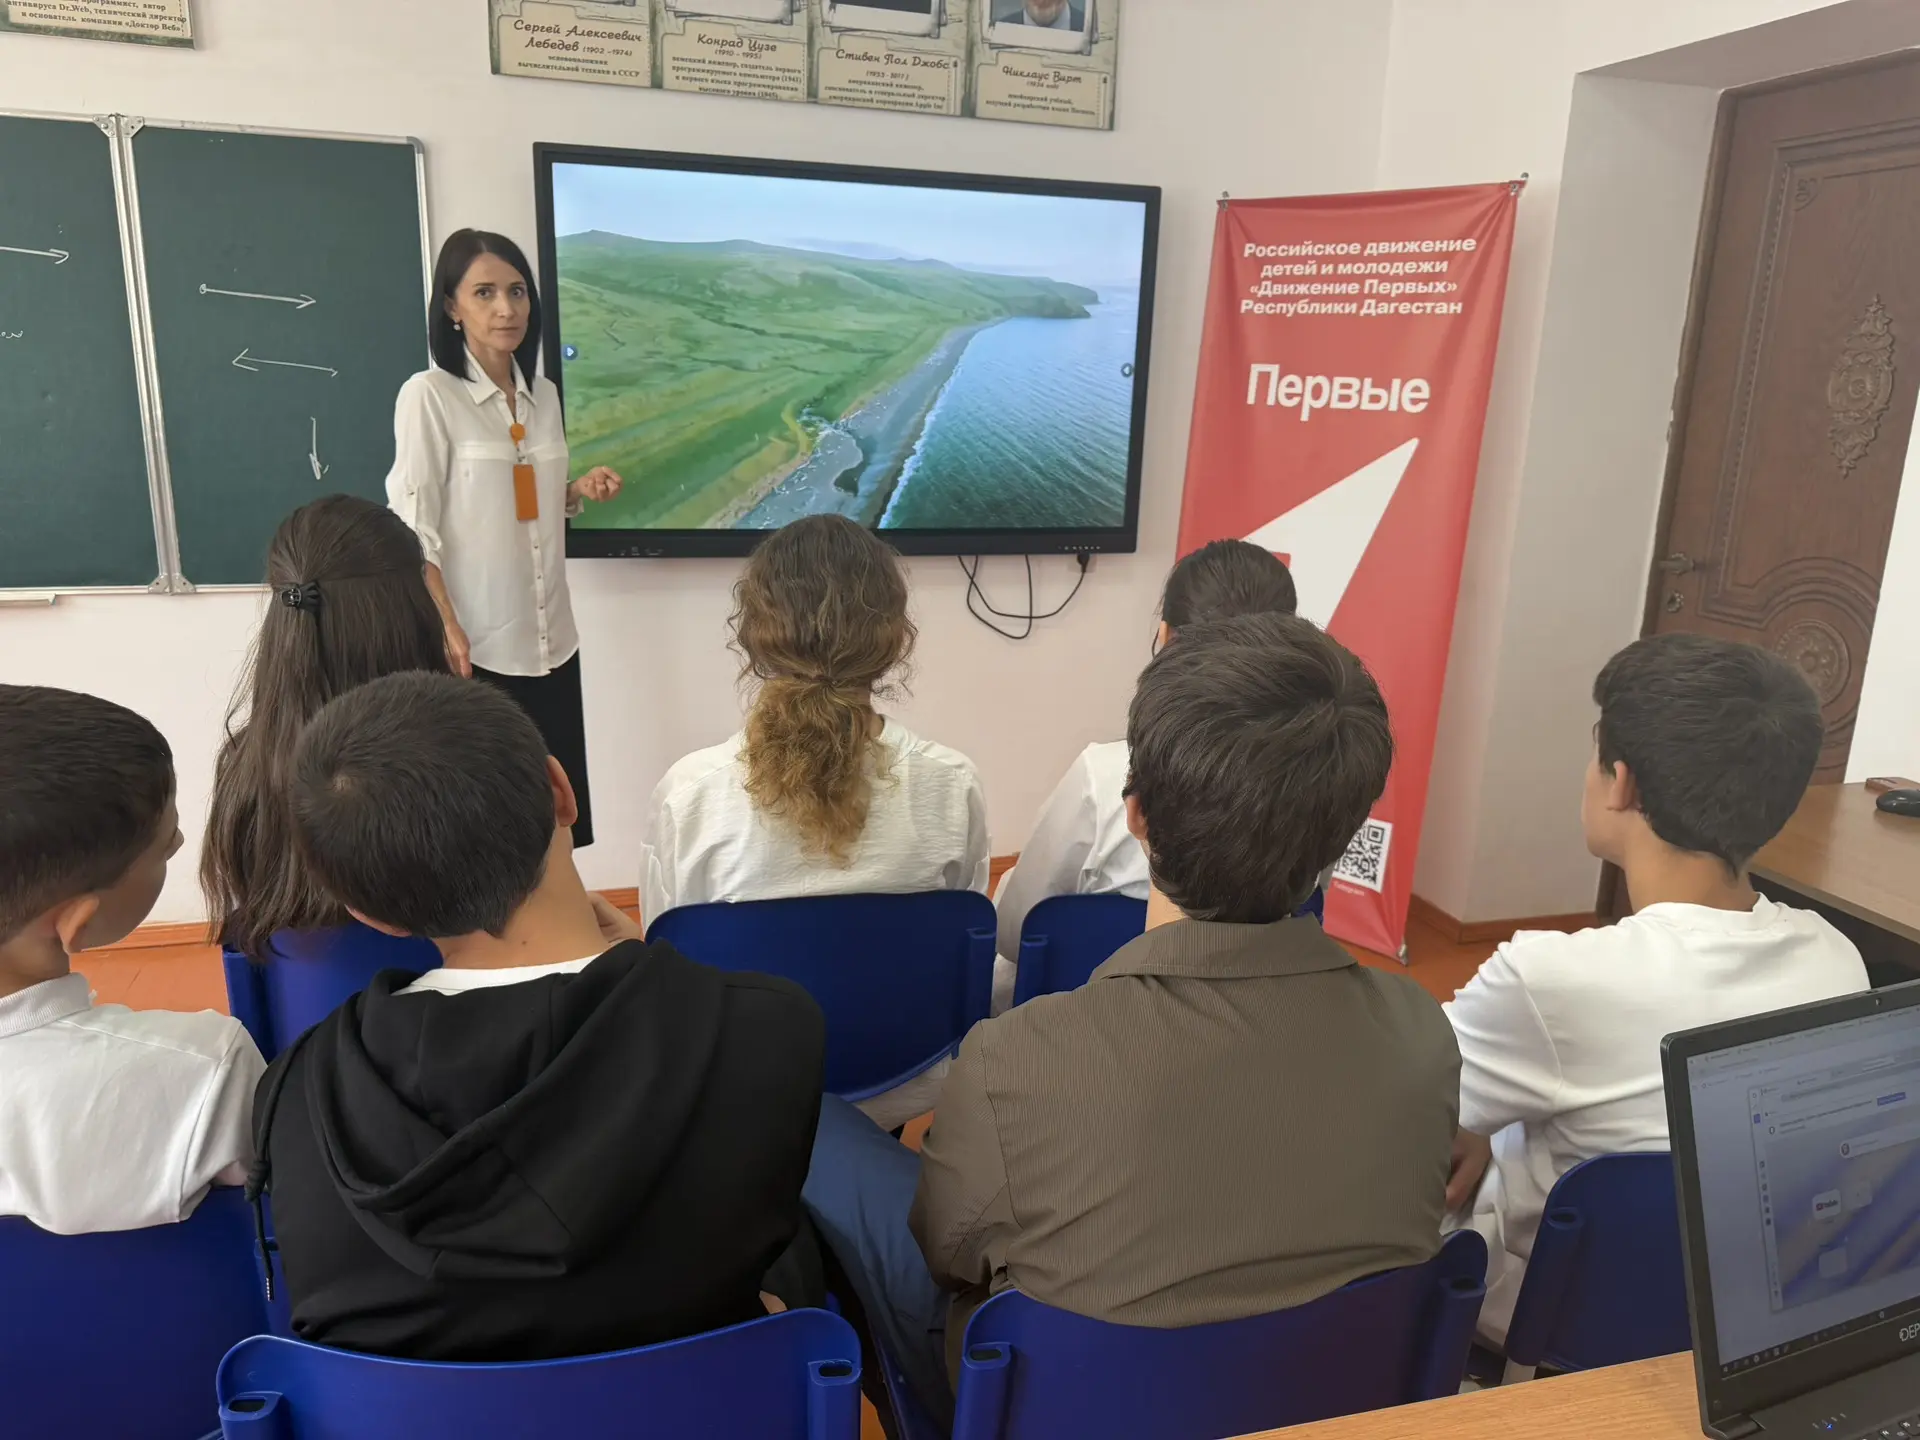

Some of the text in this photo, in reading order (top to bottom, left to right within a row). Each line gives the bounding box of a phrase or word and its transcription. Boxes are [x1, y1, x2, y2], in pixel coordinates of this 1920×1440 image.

[28, 12, 76, 22] основатель
[124, 20, 160, 30] «Доктор
[162, 24, 181, 32] Веб»
[60, 4, 92, 14] Dr.Web,
[94, 8, 147, 18] технический
[149, 14, 187, 24] директор
[513, 19, 643, 42] Сергей Алексеевич
[525, 37, 580, 52] Лебедев
[697, 33, 777, 52] Конрад Цузе
[836, 49, 950, 70] Стивен Пол Джобс
[618, 70, 640, 78] СССР
[1002, 66, 1082, 84] Никлаус Вирт
[1244, 238, 1476, 258] Российское движение
[1261, 259, 1449, 278] детей и молодежи
[1250, 279, 1458, 298] «Движение Первых»
[1240, 299, 1463, 317] Республики Дагестан
[1246, 363, 1431, 422] Первые
